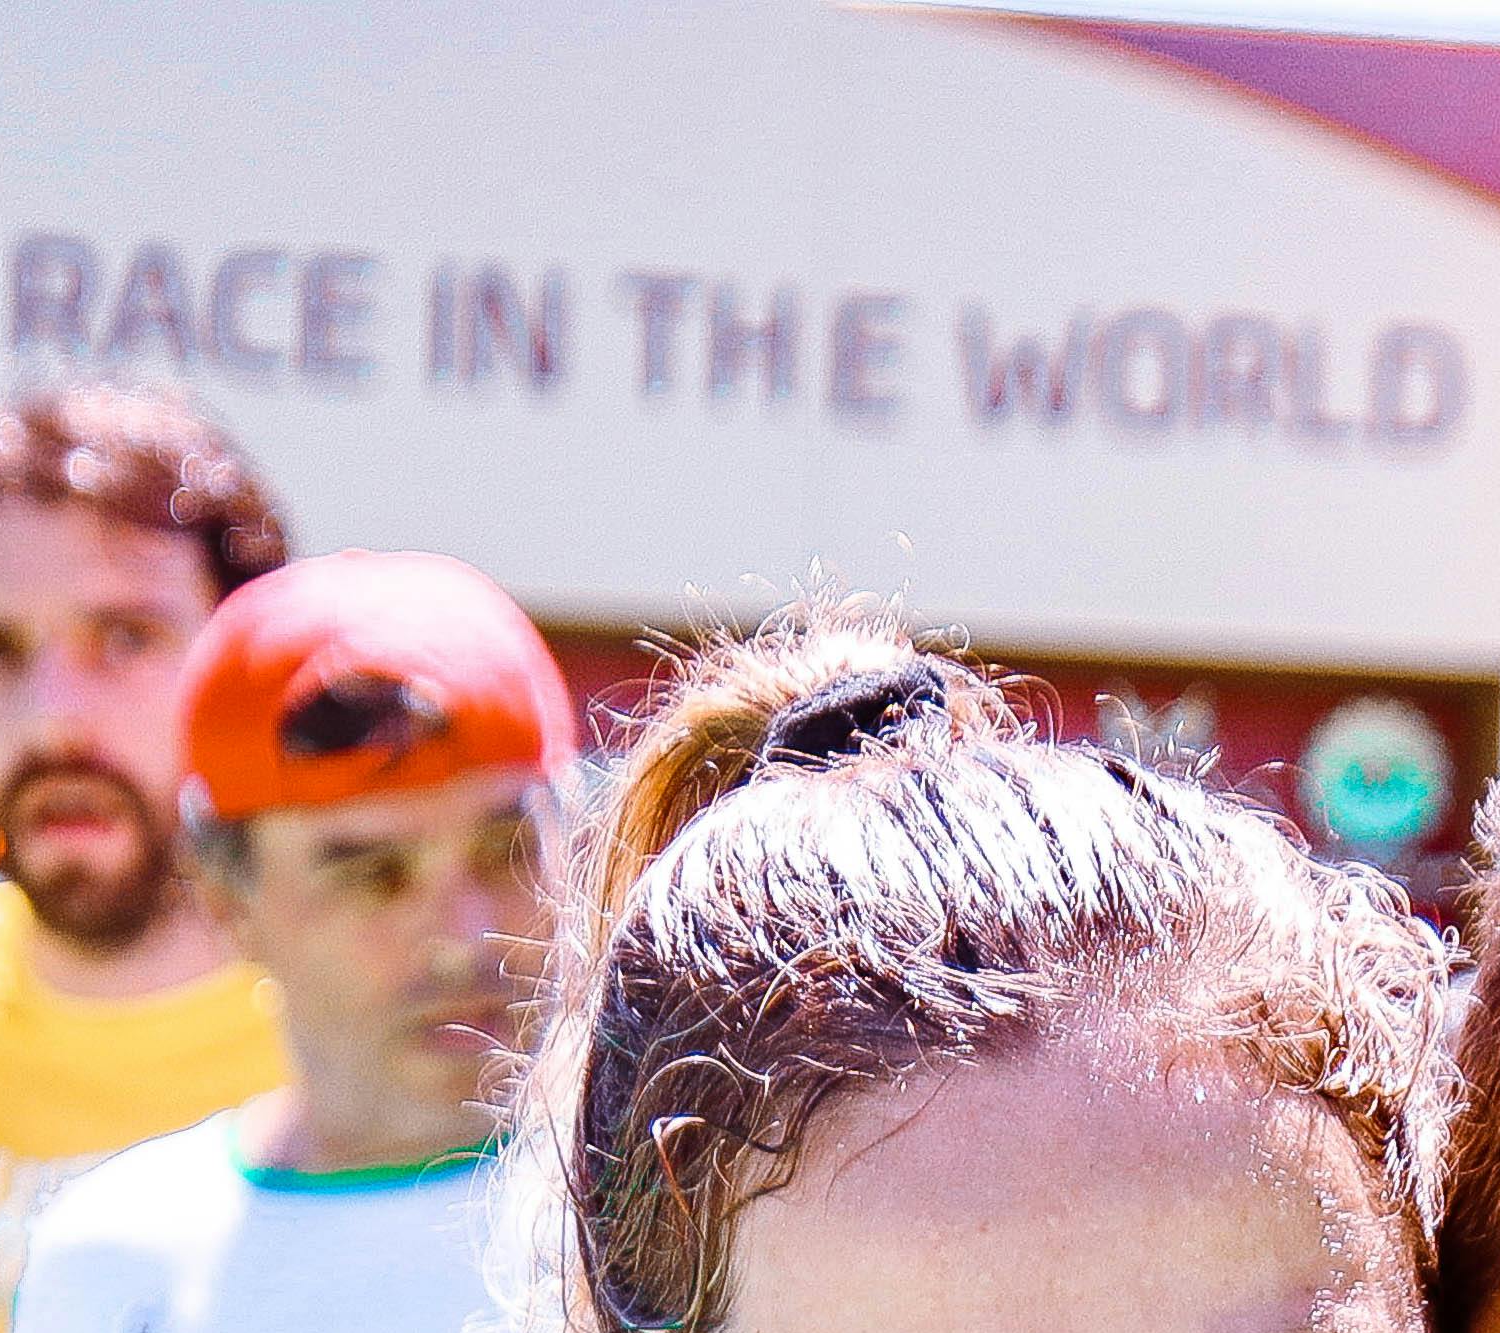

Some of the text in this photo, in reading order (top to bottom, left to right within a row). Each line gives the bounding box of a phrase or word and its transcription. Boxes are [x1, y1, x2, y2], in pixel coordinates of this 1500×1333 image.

[8, 230, 380, 386] RACE
[424, 260, 572, 388] IN
[615, 268, 913, 420] THE
[955, 302, 1470, 452] WORLD
